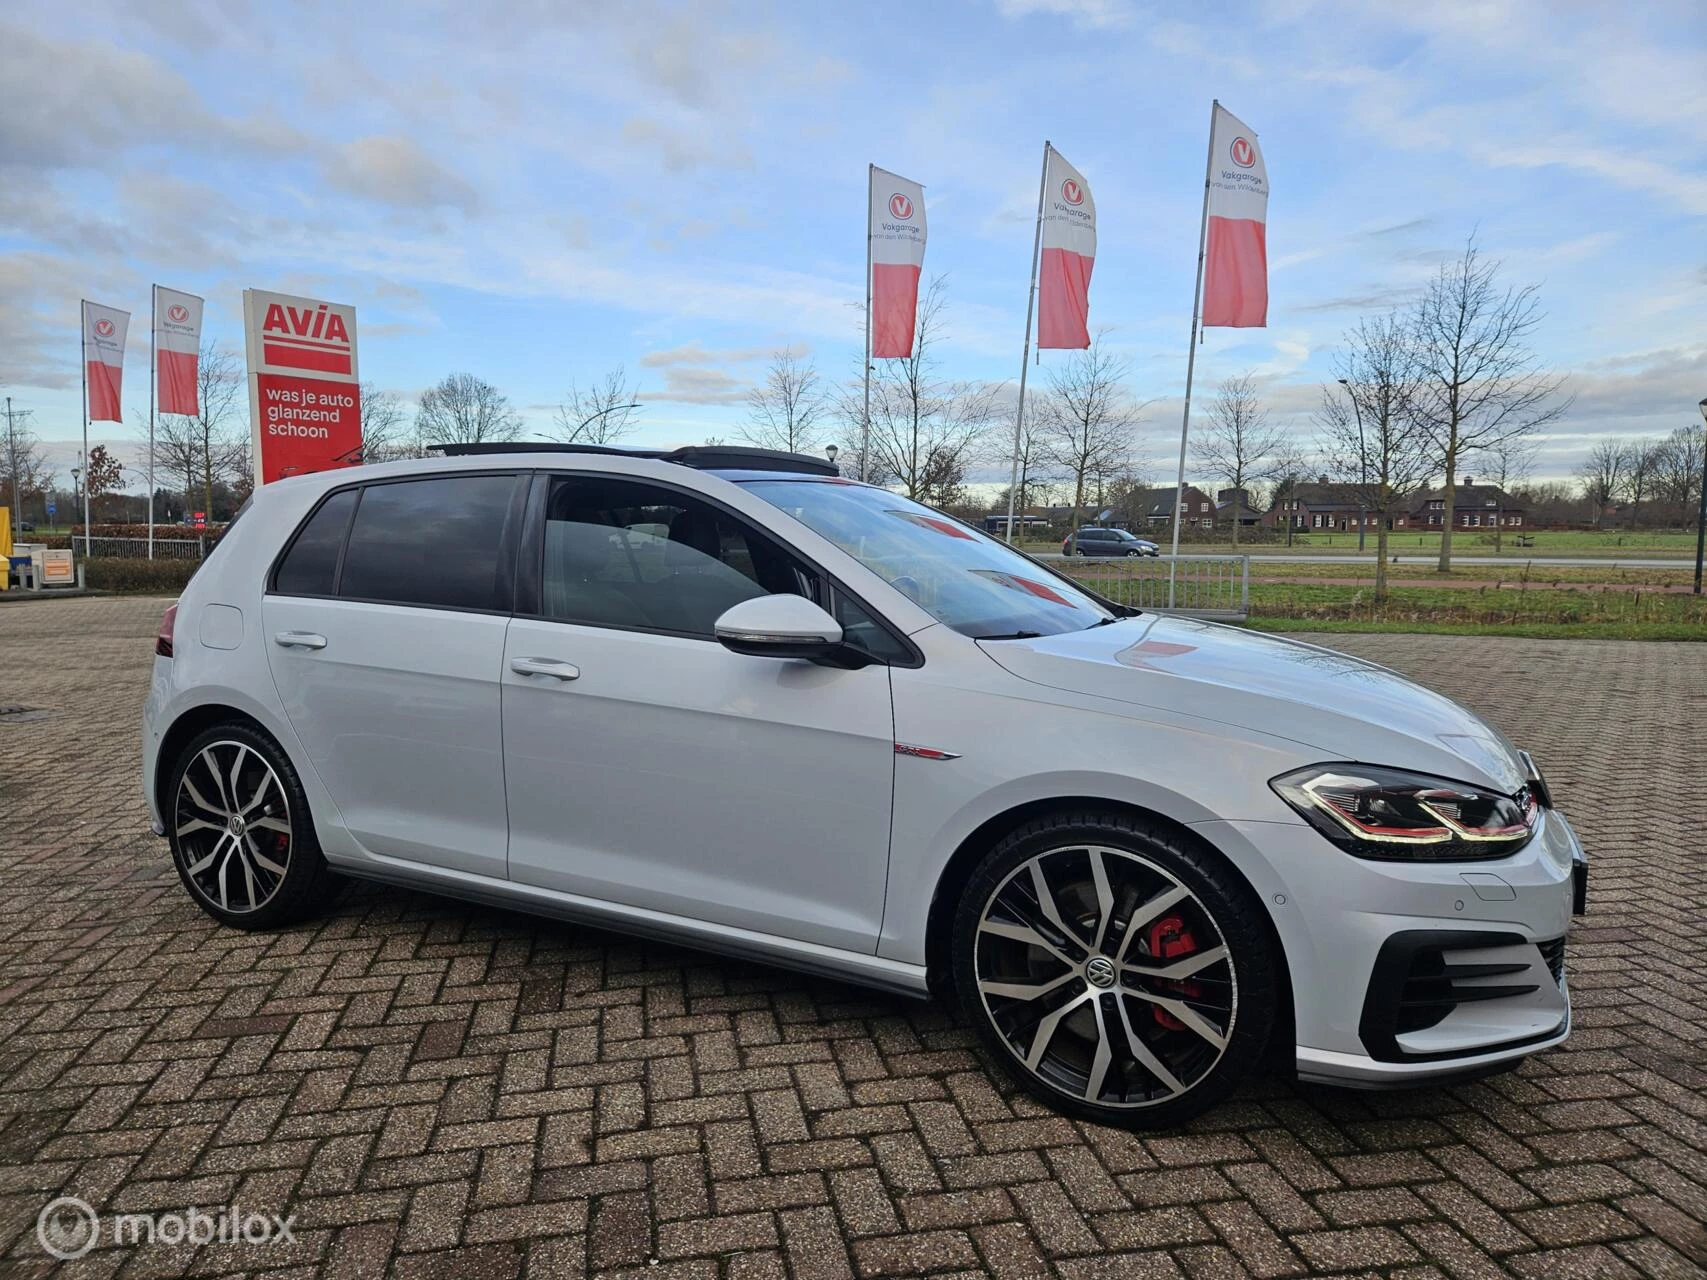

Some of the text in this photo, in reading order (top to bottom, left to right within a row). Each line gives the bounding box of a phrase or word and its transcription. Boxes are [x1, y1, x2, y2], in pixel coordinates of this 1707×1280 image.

[1222, 170, 1262, 185] Vakgarage
[882, 223, 920, 234] Vakgarage
[266, 389, 354, 407] was je auto
[267, 404, 340, 423] glanzend
[268, 422, 328, 438] schoon
